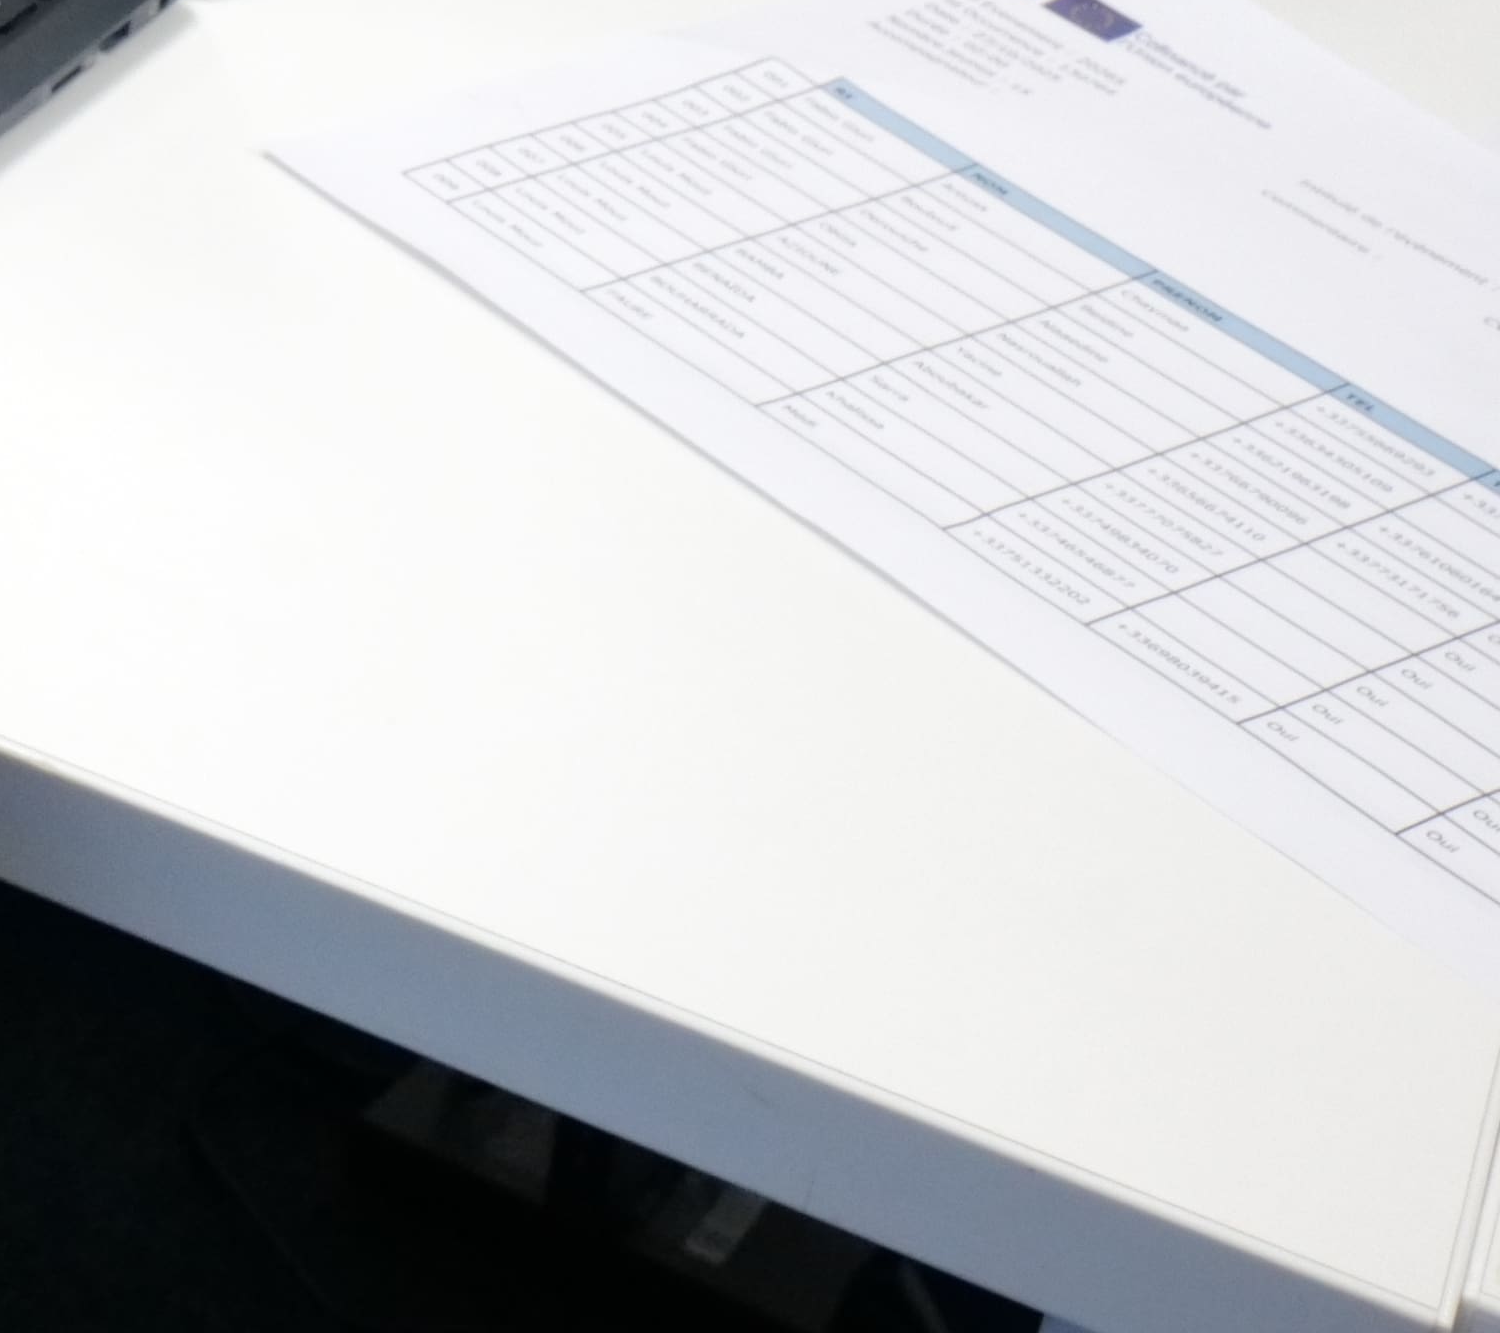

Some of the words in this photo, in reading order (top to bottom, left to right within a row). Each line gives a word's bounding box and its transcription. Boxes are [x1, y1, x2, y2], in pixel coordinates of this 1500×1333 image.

[1341, 392, 1381, 413] TEL
[1439, 650, 1478, 672] Oui
[1395, 667, 1435, 690] Oui
[1351, 684, 1392, 708] Oui
[1306, 702, 1347, 726] Oui
[1262, 719, 1302, 743] Oui
[1425, 827, 1461, 856] Oui
